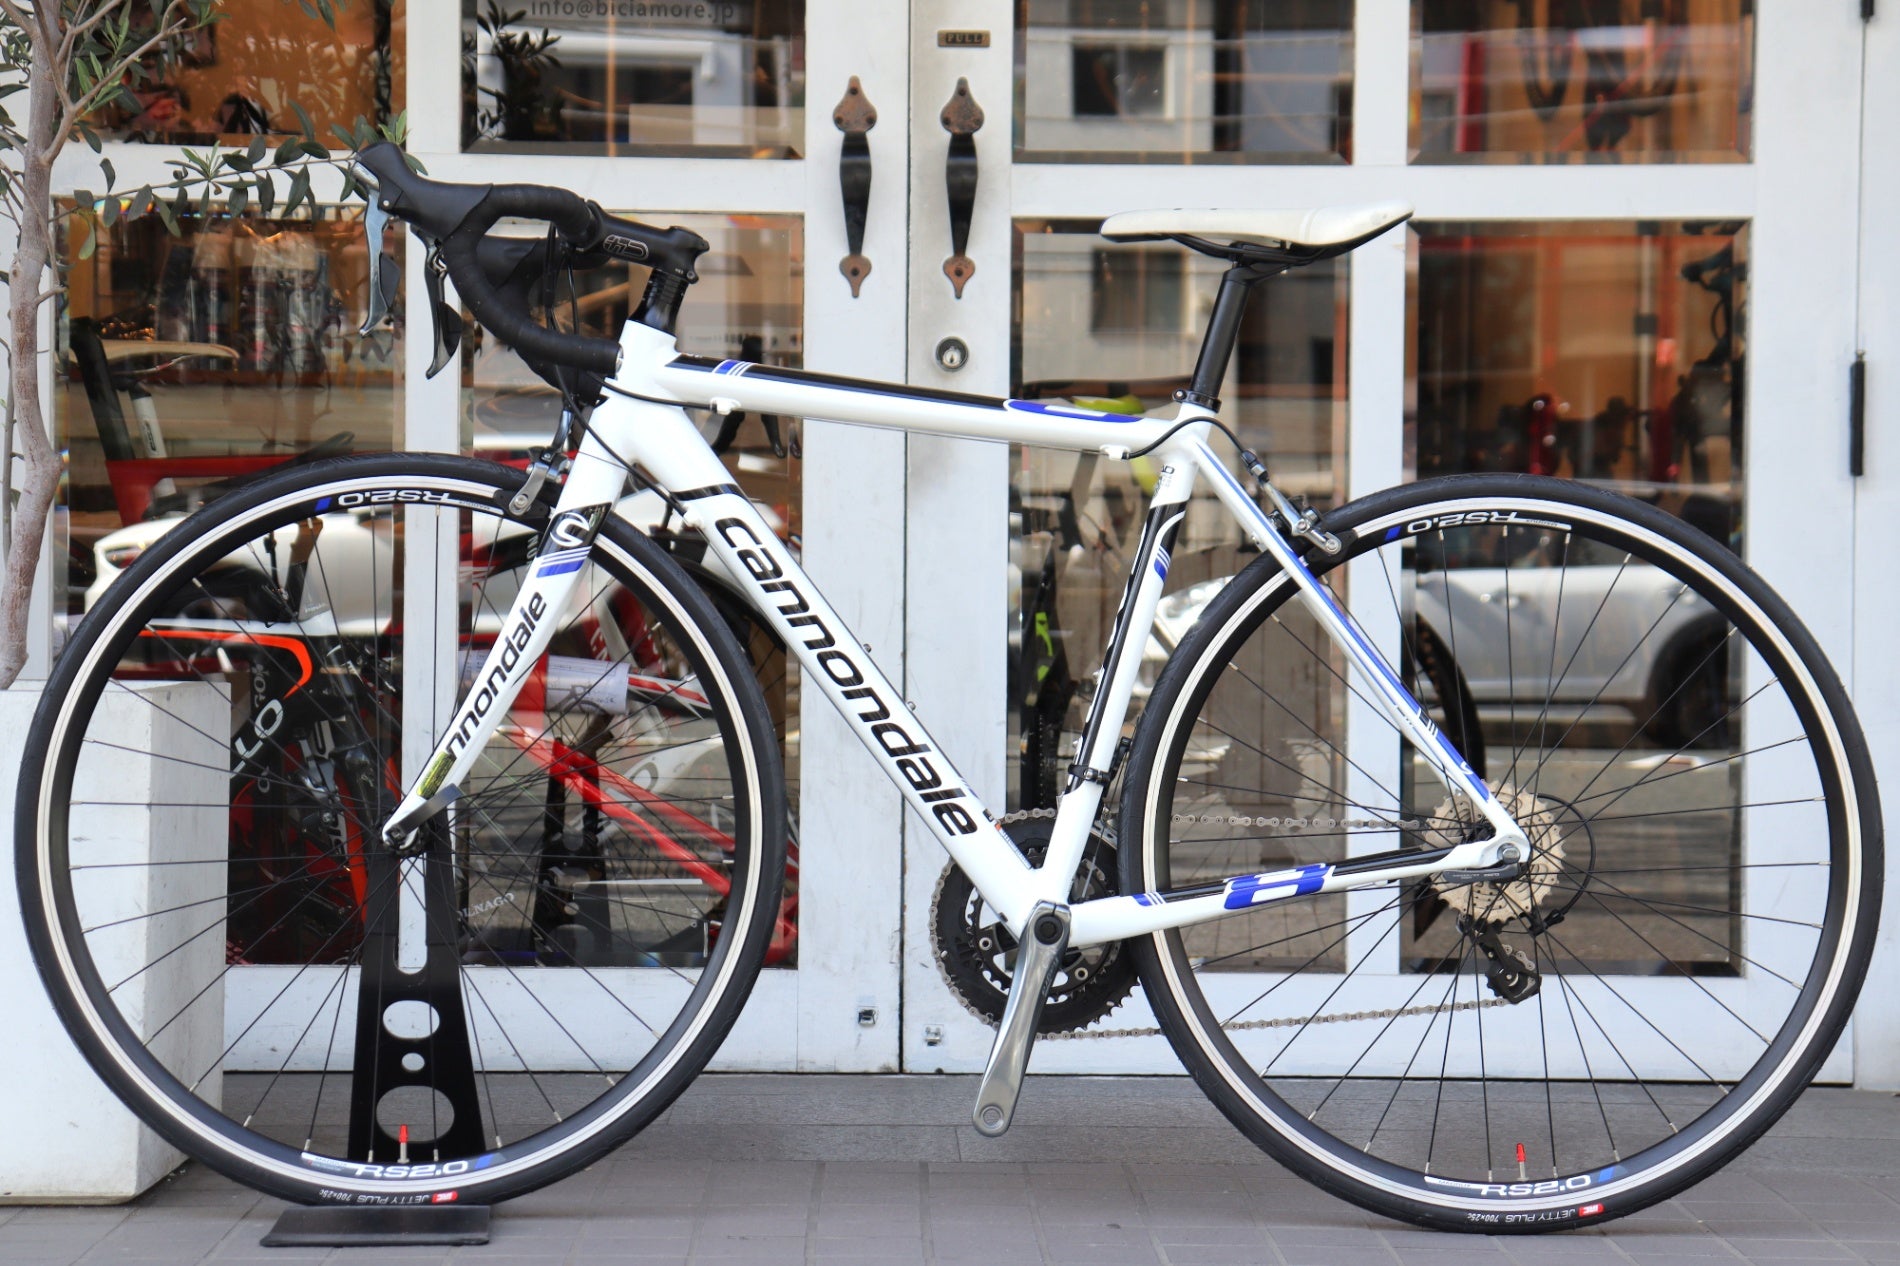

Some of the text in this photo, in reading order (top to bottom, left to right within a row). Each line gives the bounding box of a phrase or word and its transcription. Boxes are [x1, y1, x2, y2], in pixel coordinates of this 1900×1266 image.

[531, 0, 734, 24] info@biciamore.jp
[946, 32, 982, 43] PULL
[338, 489, 450, 507] RS2.0
[1407, 511, 1518, 533] RS2.0
[445, 591, 548, 760] nnondale
[715, 517, 978, 837] cannondale
[354, 1160, 469, 1178] RS2.0
[1480, 1174, 1592, 1196] RS2.0
[357, 1194, 390, 1205] PLUS
[390, 1194, 430, 1204] JETTY
[1505, 1213, 1536, 1223] PLUS
[1538, 1208, 1576, 1221] JETTY
